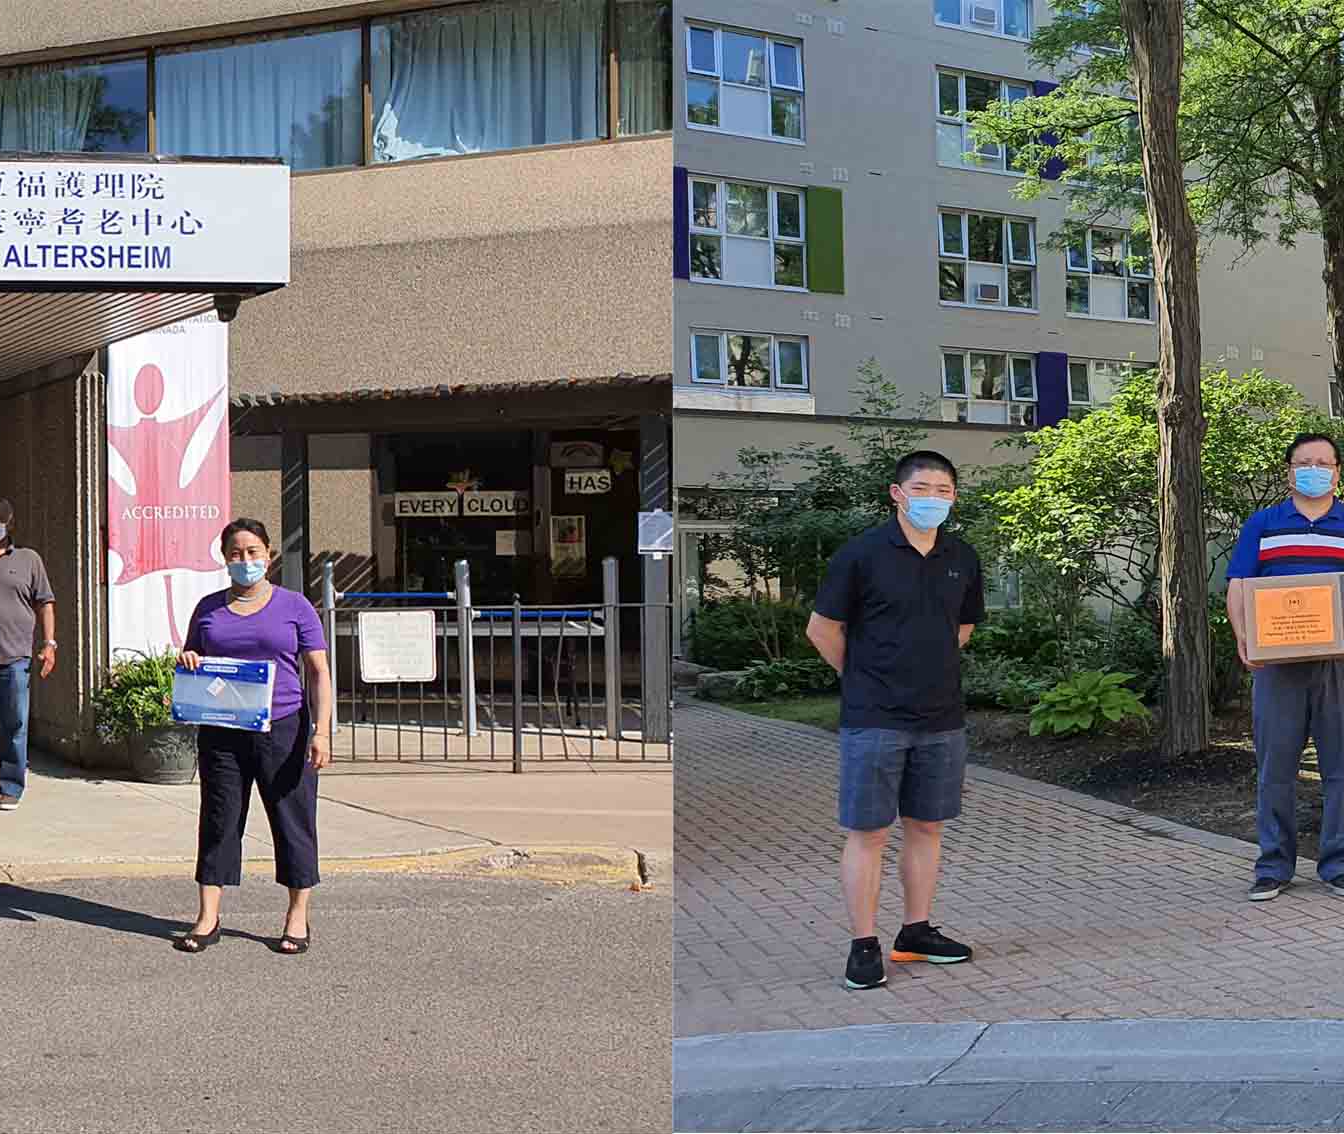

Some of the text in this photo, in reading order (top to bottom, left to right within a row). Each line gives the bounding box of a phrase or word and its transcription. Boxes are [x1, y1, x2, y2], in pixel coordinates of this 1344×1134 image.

[3, 244, 171, 269] ALTERSHEIM
[569, 475, 611, 490] HAS
[121, 505, 220, 521] ACCREDITED
[398, 498, 529, 514] EVERY CLOUD
